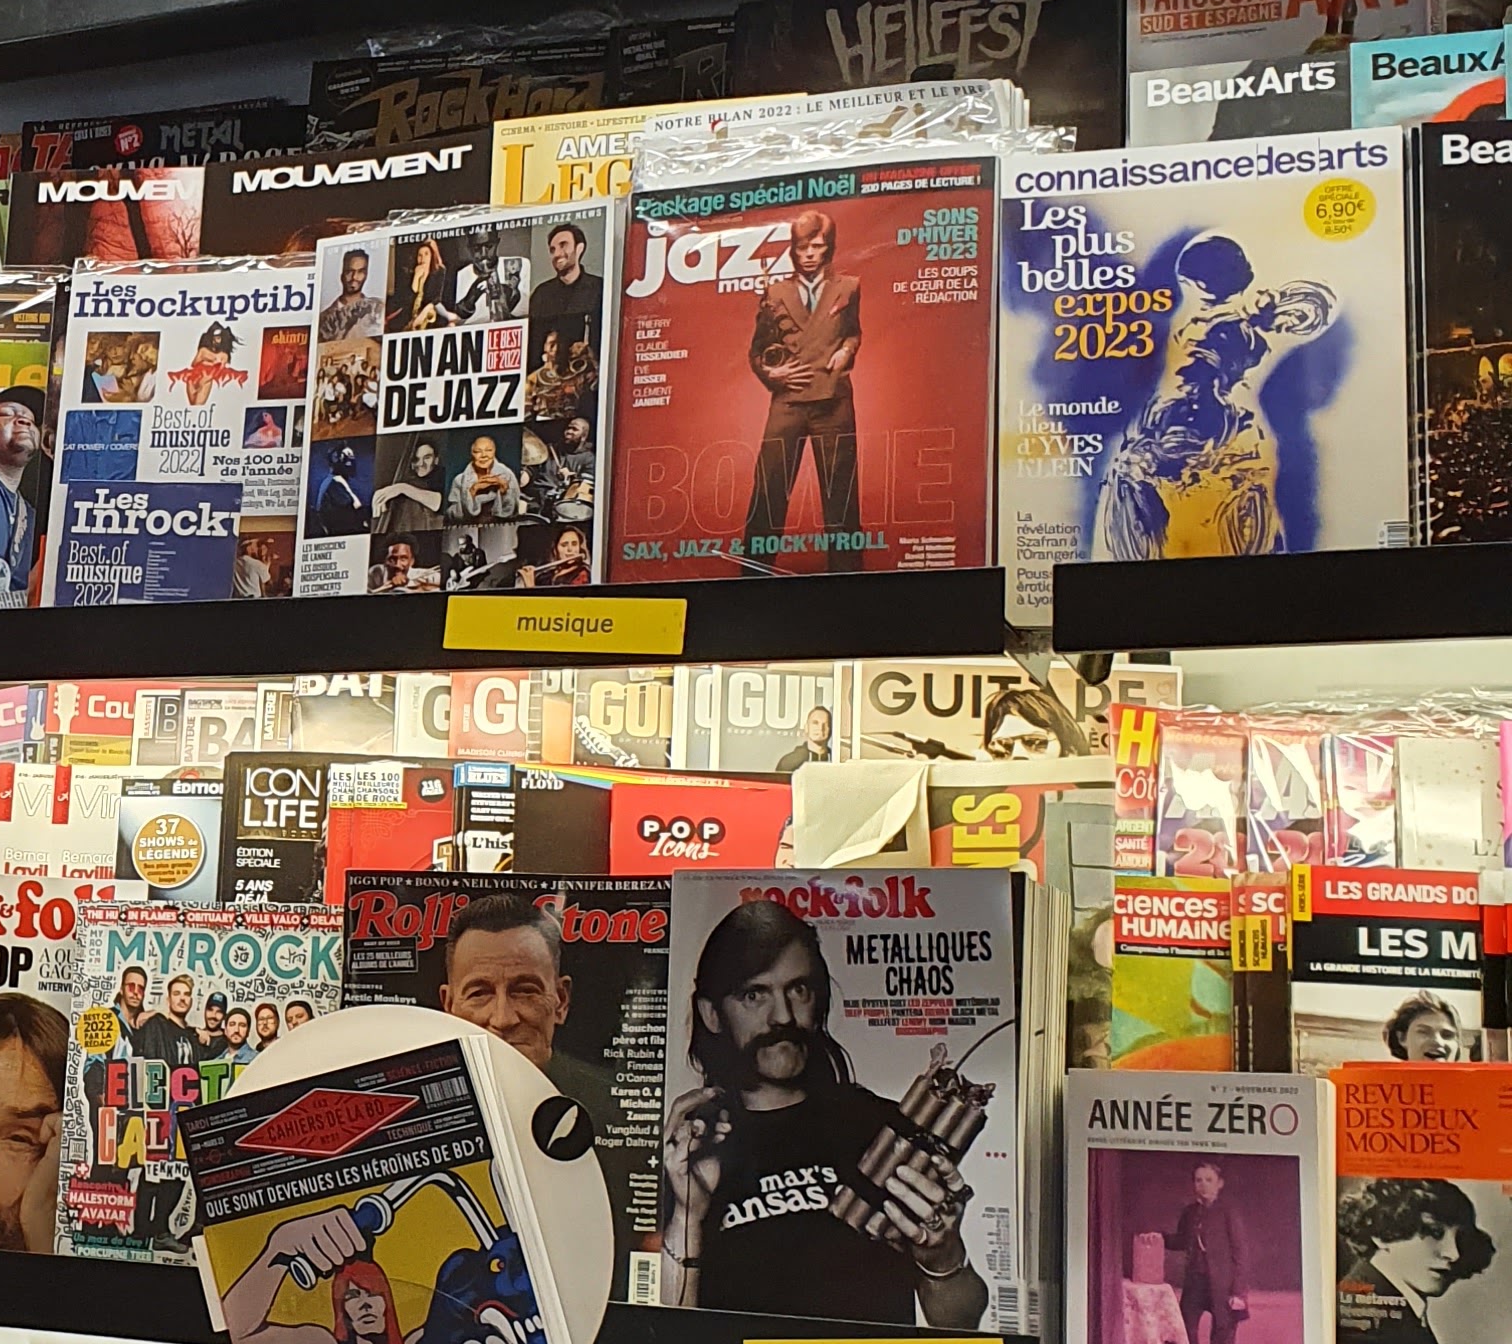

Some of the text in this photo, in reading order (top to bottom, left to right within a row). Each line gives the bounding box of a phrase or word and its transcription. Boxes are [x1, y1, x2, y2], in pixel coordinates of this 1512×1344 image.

[1141, 2, 1281, 33] SUD ET ESPAGNE
[233, 144, 473, 195] MOUVEMENT
[635, 174, 856, 219] Package spécial Noël
[1316, 201, 1366, 219] 6,90€
[626, 222, 796, 298] jazz
[1051, 228, 1135, 269] plus
[1018, 260, 1135, 294] belles
[1054, 287, 1173, 332] expos
[386, 330, 485, 382] UN AN
[383, 373, 522, 429] DE JAZZ
[149, 427, 231, 475] musique
[94, 488, 149, 508] Les
[623, 428, 955, 538] BOWIE
[1016, 511, 1033, 523] La
[66, 564, 143, 605] musique
[517, 613, 614, 638] musique
[245, 767, 321, 797] ICON
[244, 800, 319, 829] LIFE
[643, 820, 722, 840] POP
[649, 839, 720, 862] Icons
[846, 931, 992, 966] METALLIQUES
[885, 964, 955, 998] CHAOS
[1310, 962, 1322, 972] LA
[1324, 962, 1359, 974] GRANDE
[1361, 963, 1399, 976] HISTOIRE
[1401, 965, 1418, 977] DE
[1420, 966, 1430, 977] LA
[1088, 1093, 1299, 1136] ANNÉE ZÉRO
[1344, 1107, 1479, 1132] DES DEUX
[594, 1136, 659, 1150] Roger Daltrey
[1344, 1131, 1461, 1156] MONDES
[205, 1194, 229, 1218] QUE
[231, 1188, 265, 1212] SONT
[268, 1174, 335, 1206] DEVENUES
[336, 1166, 361, 1187] LES
[362, 1150, 429, 1183] HÉROÏNES
[431, 1145, 450, 1165] DE
[453, 1138, 474, 1159] BD
[760, 1163, 838, 1196] max's
[70, 1192, 134, 1208] HALESTORM
